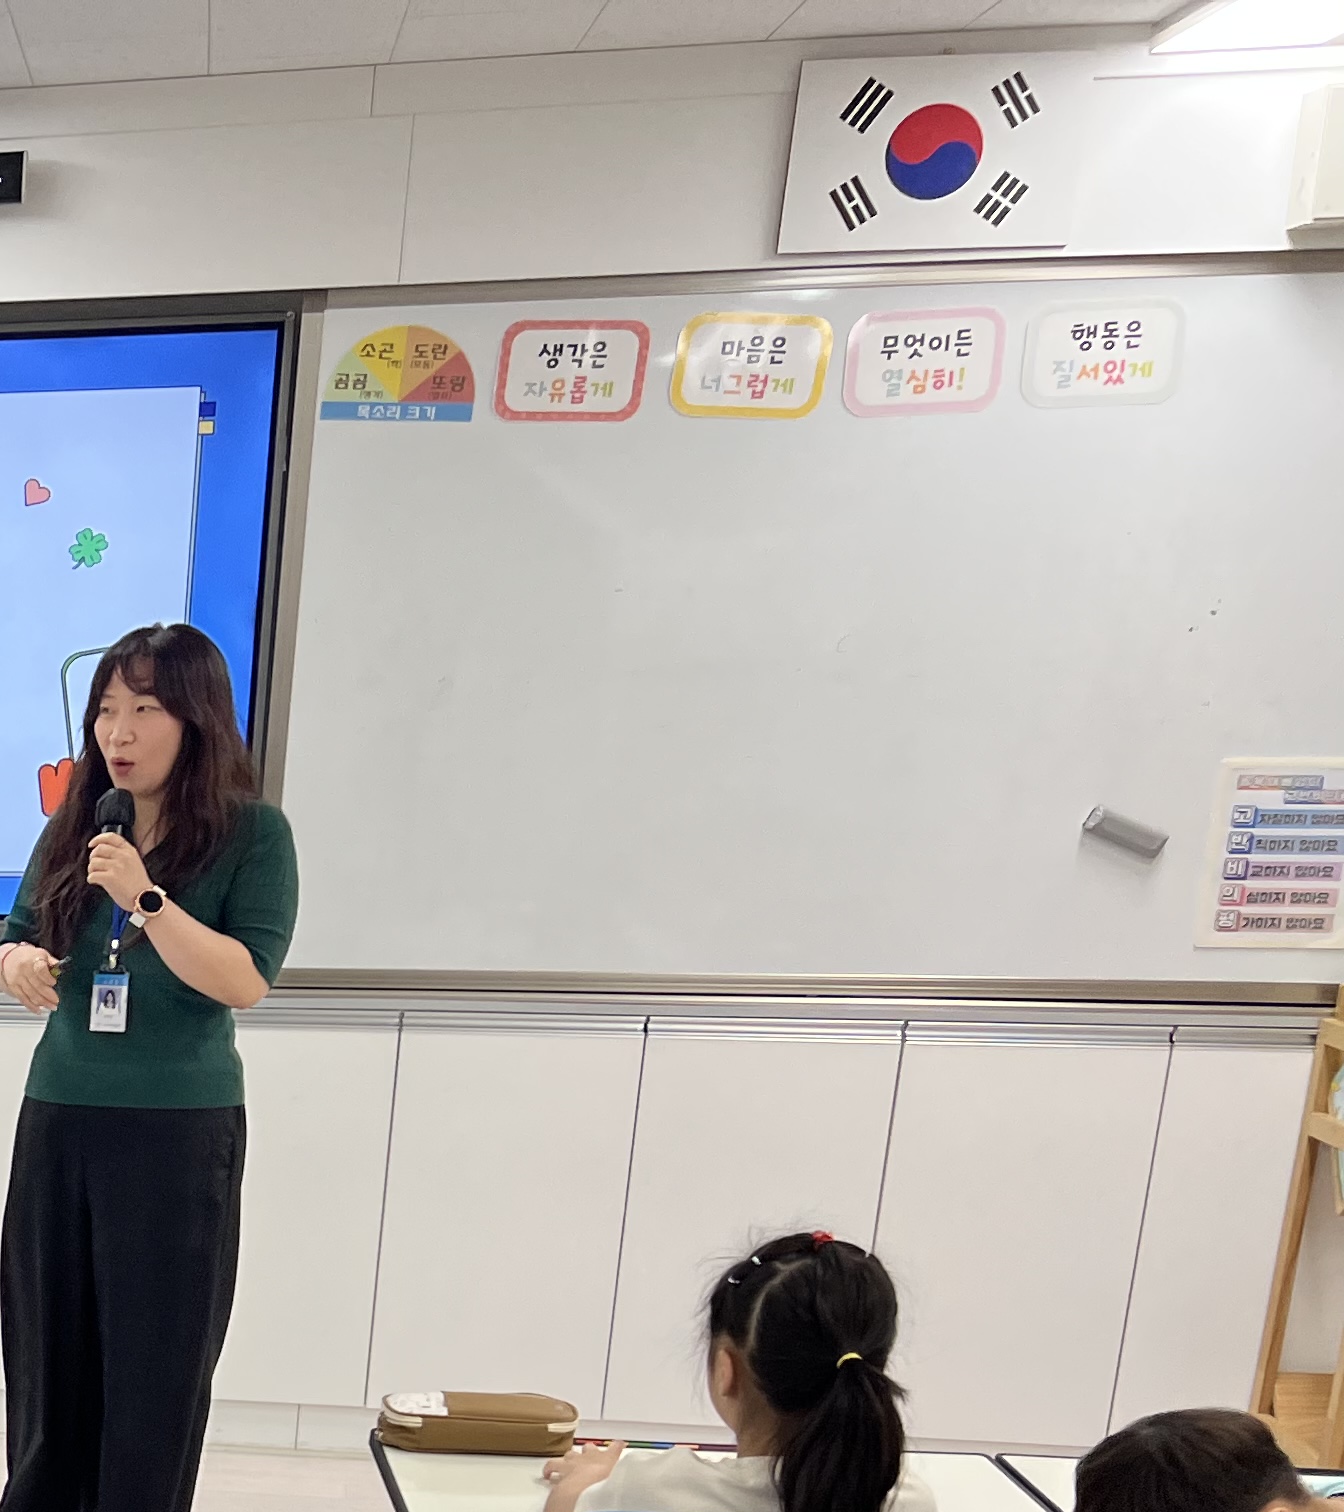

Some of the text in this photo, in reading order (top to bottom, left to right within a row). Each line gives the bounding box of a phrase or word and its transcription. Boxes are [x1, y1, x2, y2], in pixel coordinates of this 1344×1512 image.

[720, 335, 787, 365] 마음은
[880, 328, 973, 360] 무엇이든
[1070, 320, 1143, 351] 행동은
[359, 343, 394, 360] 소곤
[413, 343, 449, 360] 도란
[538, 341, 608, 369] 생각은
[431, 375, 466, 393] 또랑
[700, 373, 795, 400] 너그럽게
[881, 367, 966, 398] 열심히!
[1051, 359, 1155, 390] 질서있게
[522, 375, 614, 405] 자유롭게
[357, 405, 436, 420] 목소리 크기
